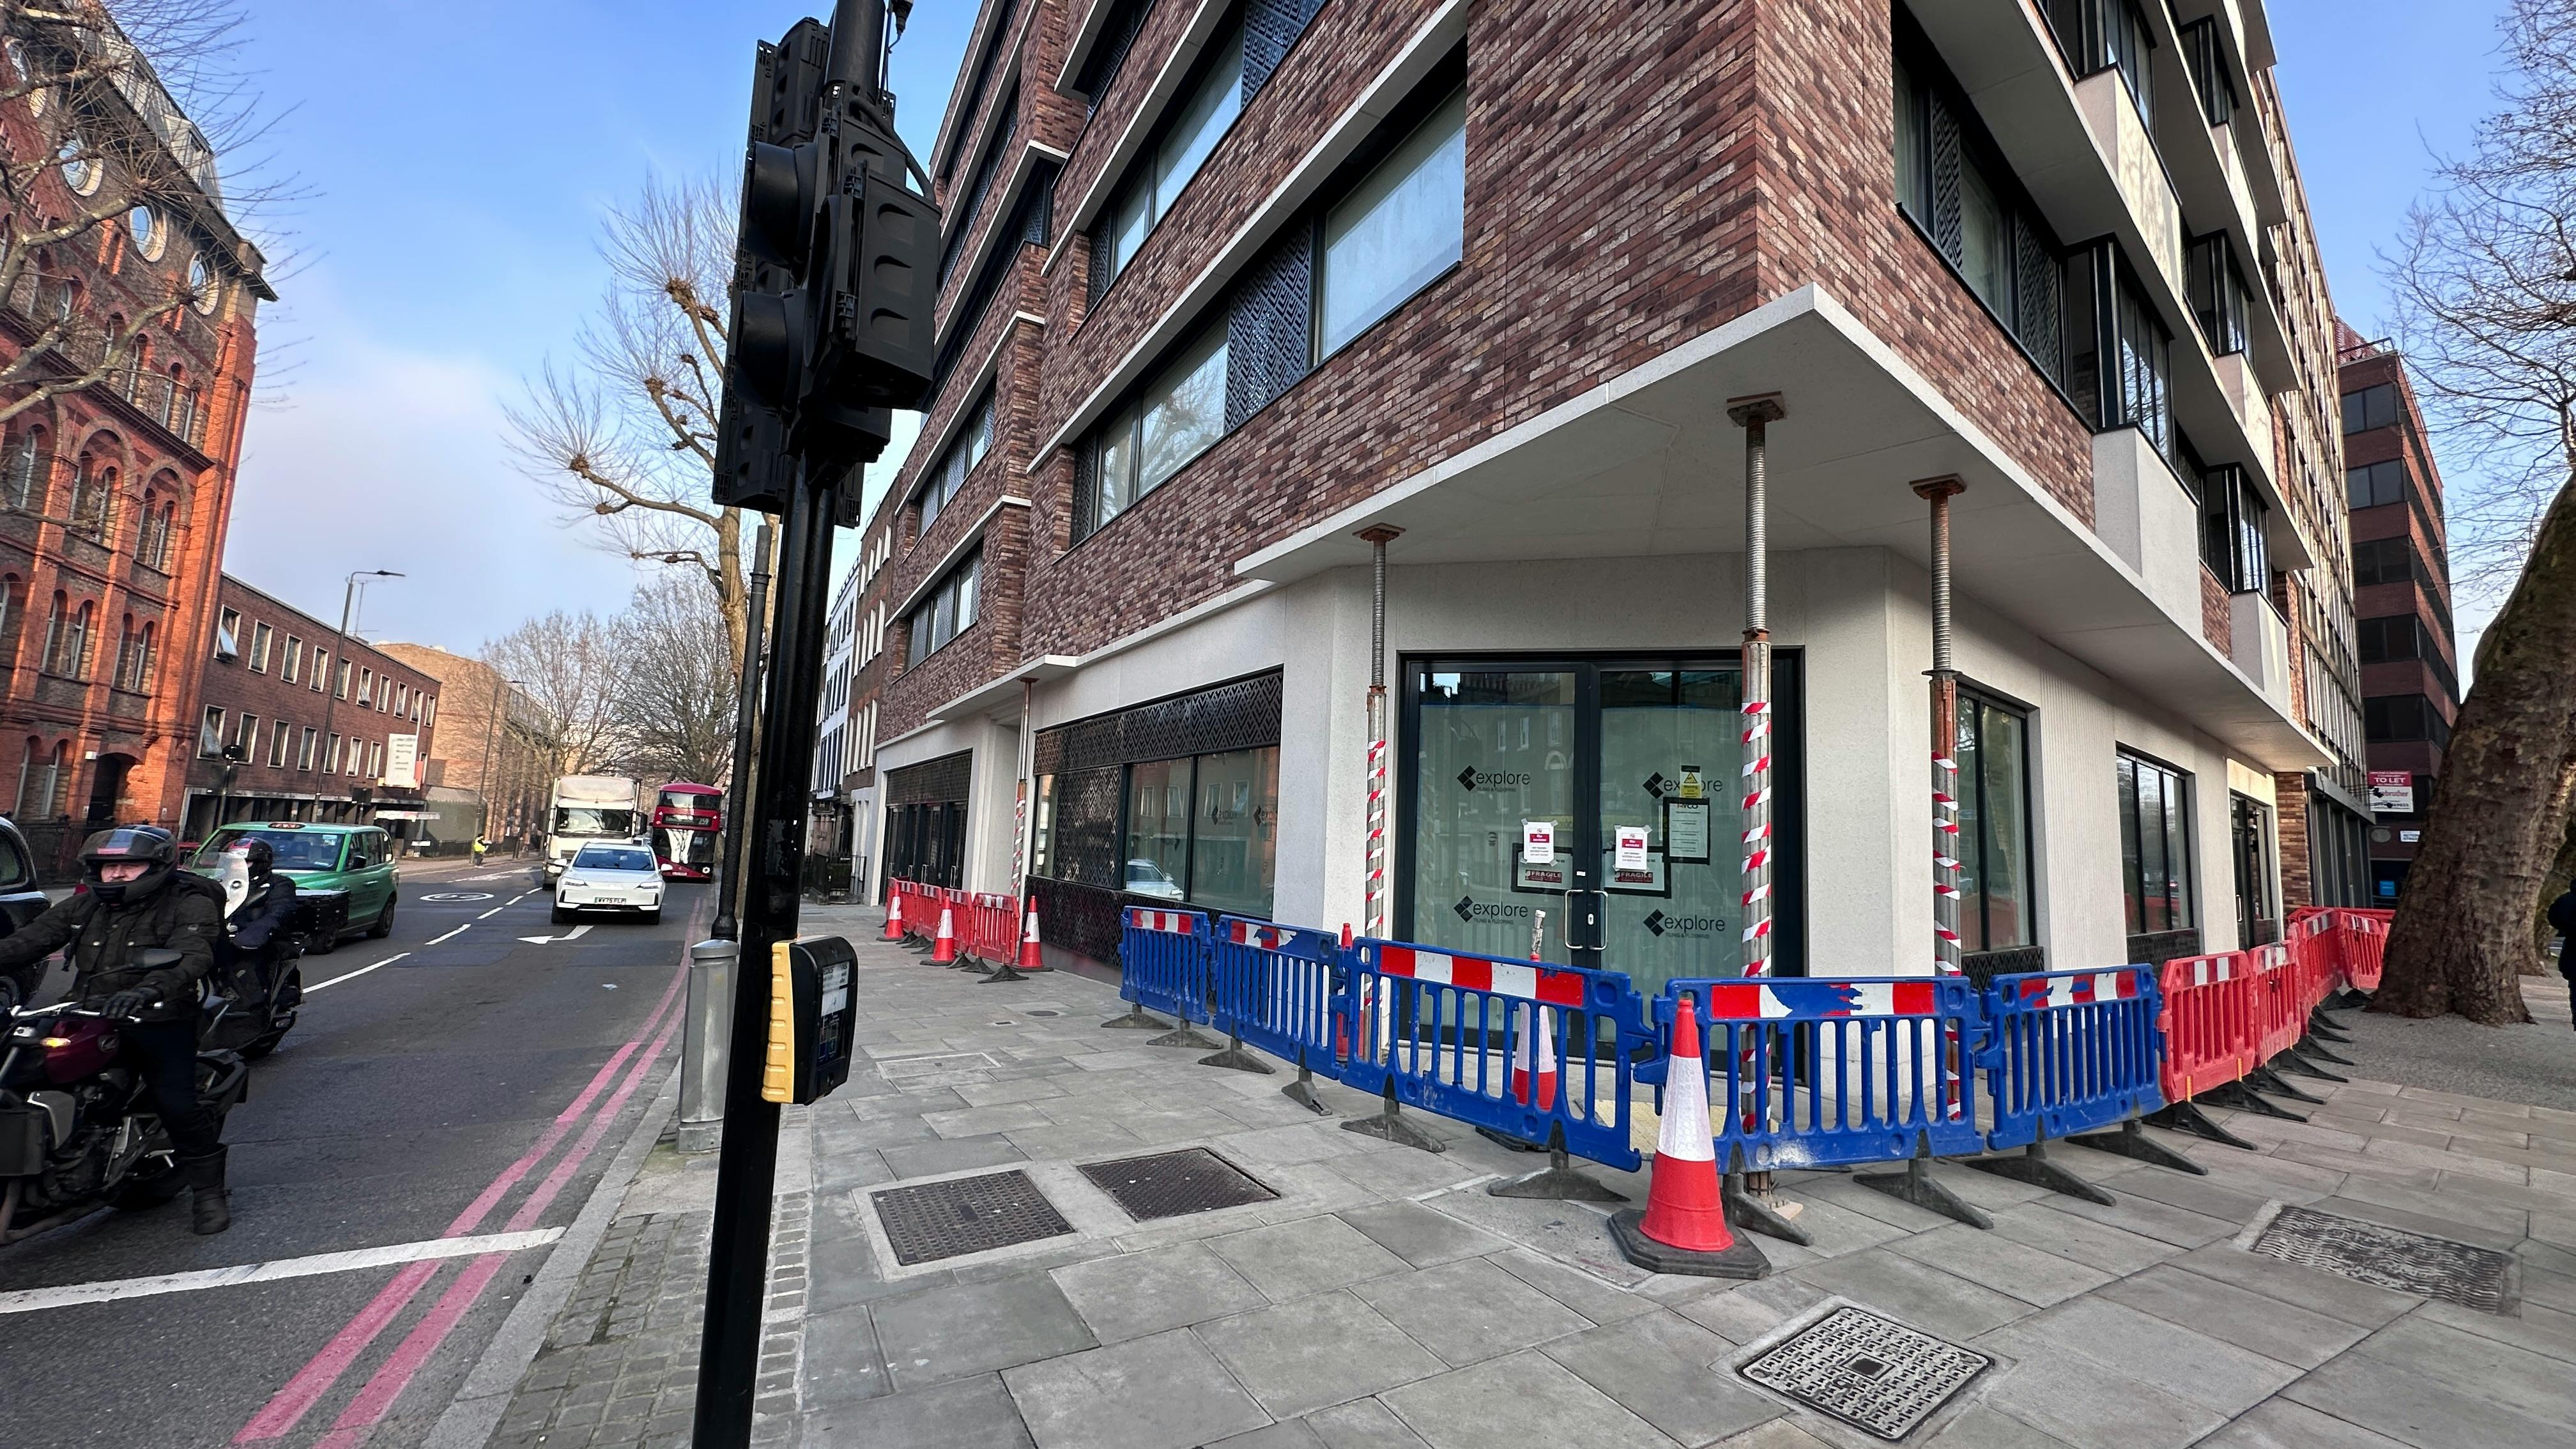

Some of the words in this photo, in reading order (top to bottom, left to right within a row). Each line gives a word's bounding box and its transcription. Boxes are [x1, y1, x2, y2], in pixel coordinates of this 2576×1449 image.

[1476, 770, 1530, 787] explore
[1664, 778, 1723, 792] exore
[1473, 901, 1528, 919] explore
[1664, 915, 1725, 933] explore
